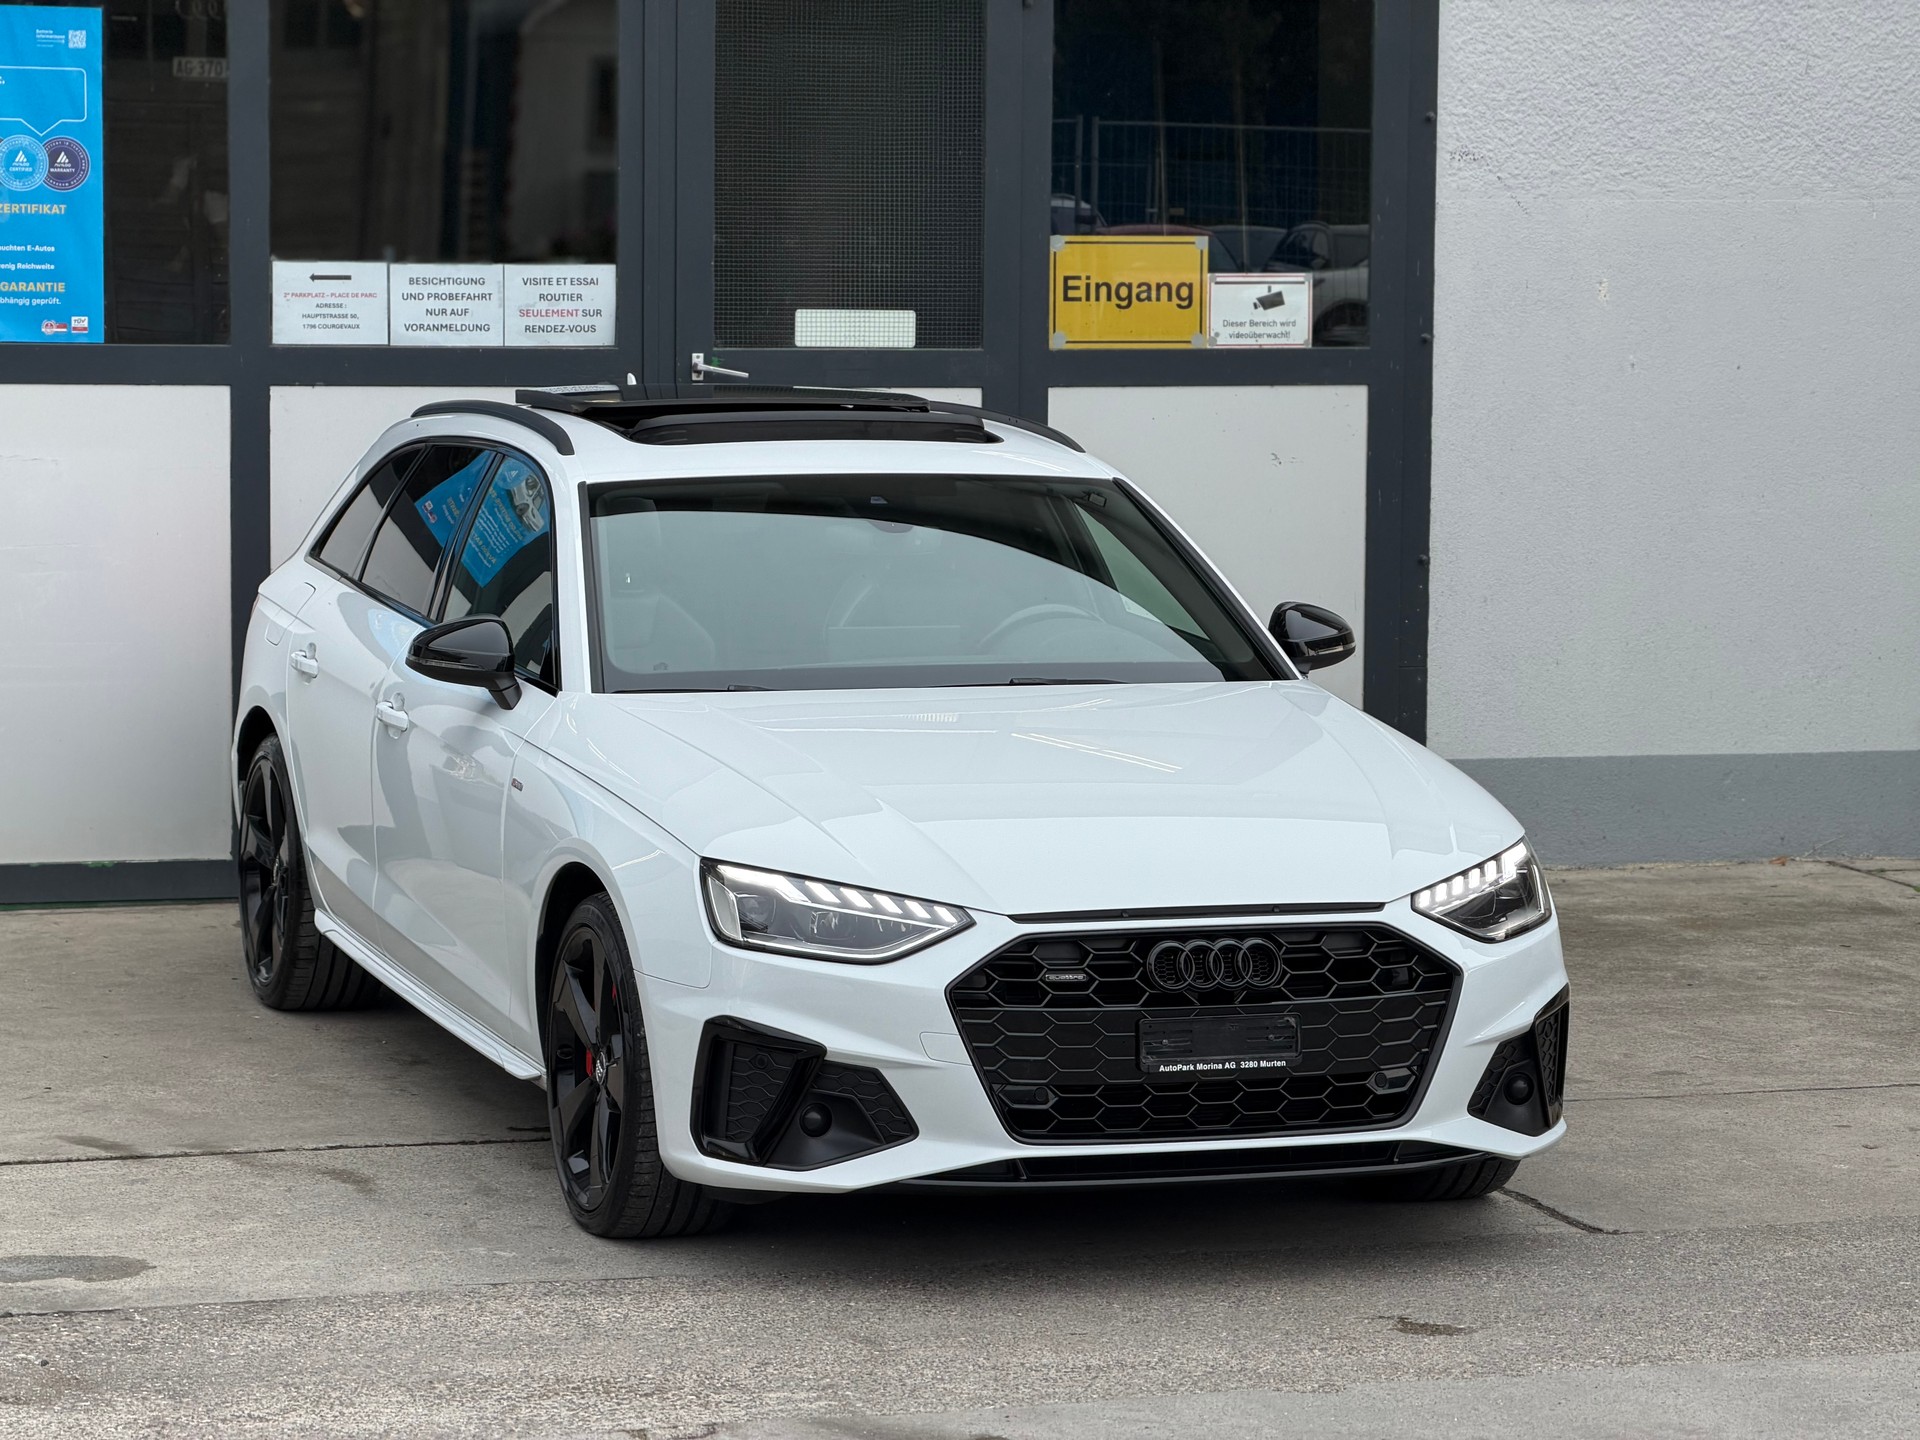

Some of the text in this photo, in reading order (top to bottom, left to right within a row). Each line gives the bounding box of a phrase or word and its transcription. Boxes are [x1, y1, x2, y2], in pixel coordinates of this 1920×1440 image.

[0, 262, 16, 271] enig
[409, 277, 486, 286] BESICHTIGUNG
[522, 278, 599, 286] VISITE ET ESSAI
[0, 282, 66, 292] GARANTIE
[401, 293, 493, 301] UND PROBEFAHRT
[1063, 275, 1194, 310] Eingang
[539, 293, 583, 302] ROUTIER
[425, 308, 470, 317] NUR AUF
[519, 309, 603, 318] SEULEMENT SUR
[404, 323, 491, 332] VORANMELDUNG
[1222, 319, 1297, 328] Dieser Bereich wird
[524, 324, 597, 333] RENDEZ-VOUS
[1229, 331, 1291, 340] videoüberwacht!
[1196, 1062, 1223, 1071] Morina
[1224, 1061, 1236, 1069] AG
[1240, 1060, 1258, 1068] 3280
[1259, 1060, 1287, 1068] Murten
